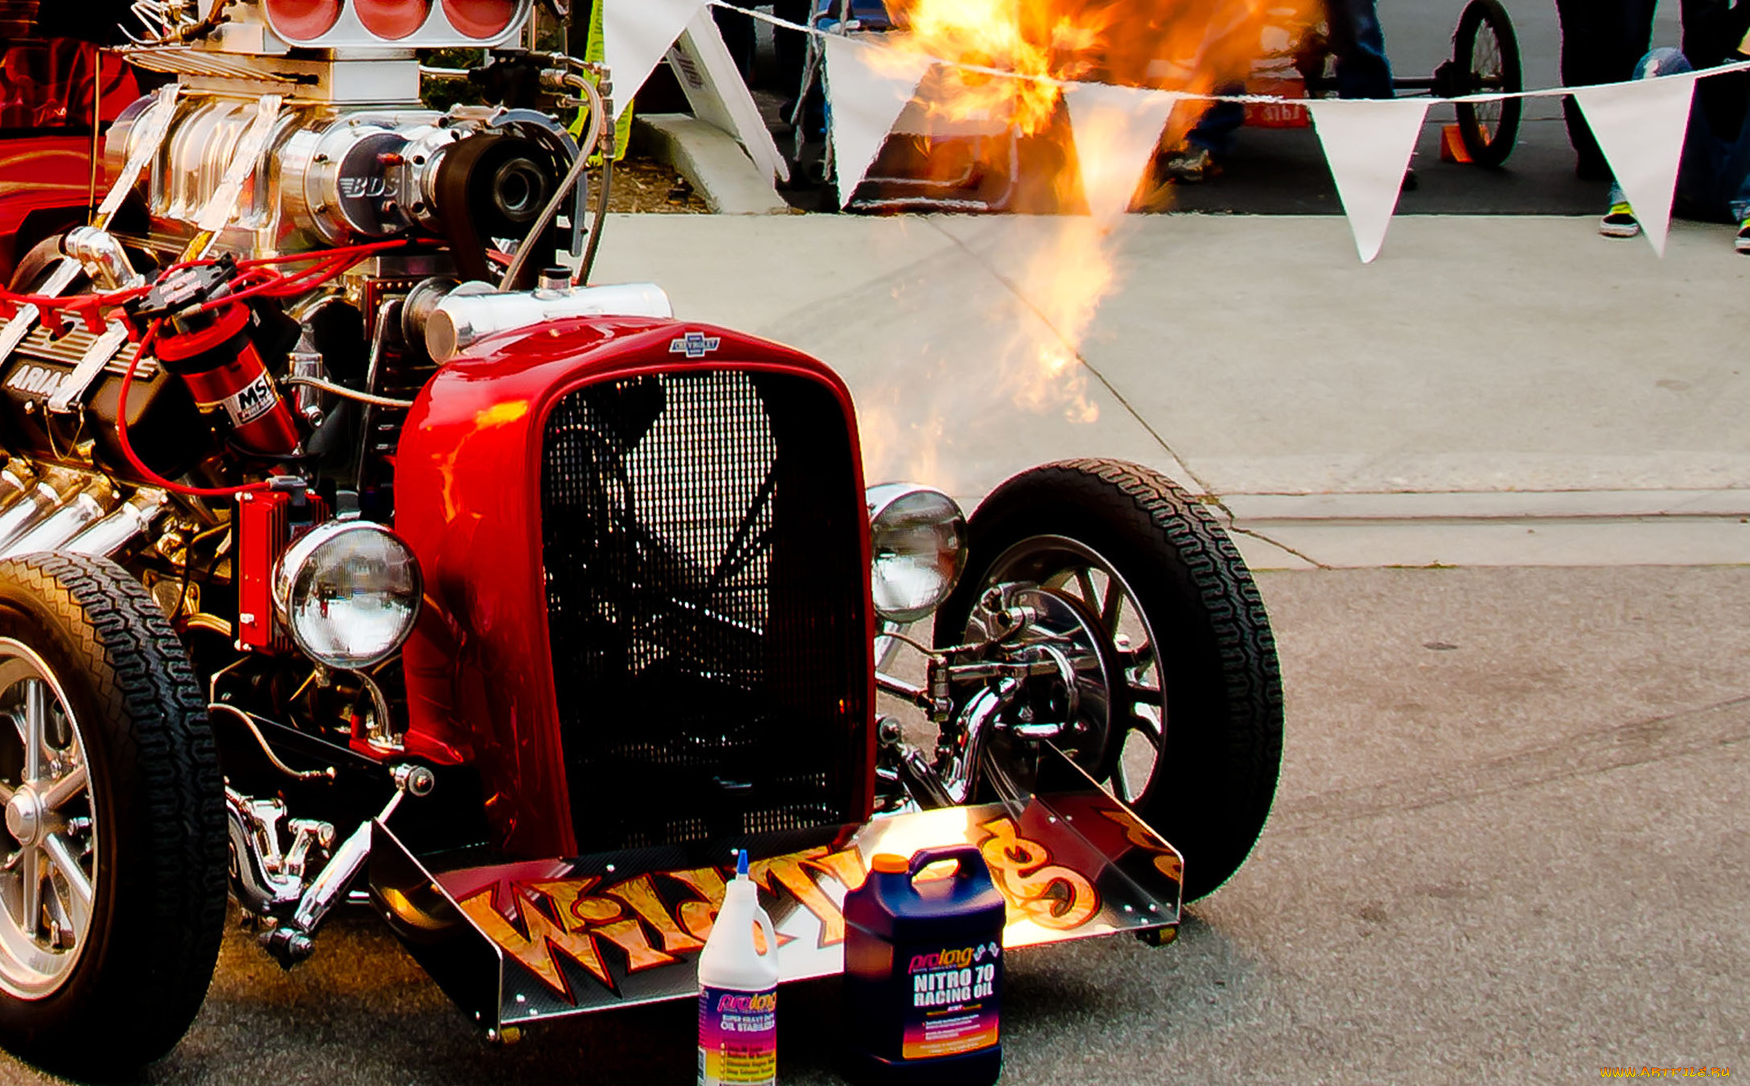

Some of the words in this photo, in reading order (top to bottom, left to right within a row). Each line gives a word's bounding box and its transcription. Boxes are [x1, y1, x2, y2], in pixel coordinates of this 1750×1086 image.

[347, 177, 399, 198] BDS
[908, 947, 974, 974] prolong
[914, 968, 971, 993] NITRO
[975, 963, 994, 984] 70
[914, 986, 971, 1007] RACING
[974, 982, 993, 999] OIL
[721, 1021, 735, 1031] OIL
